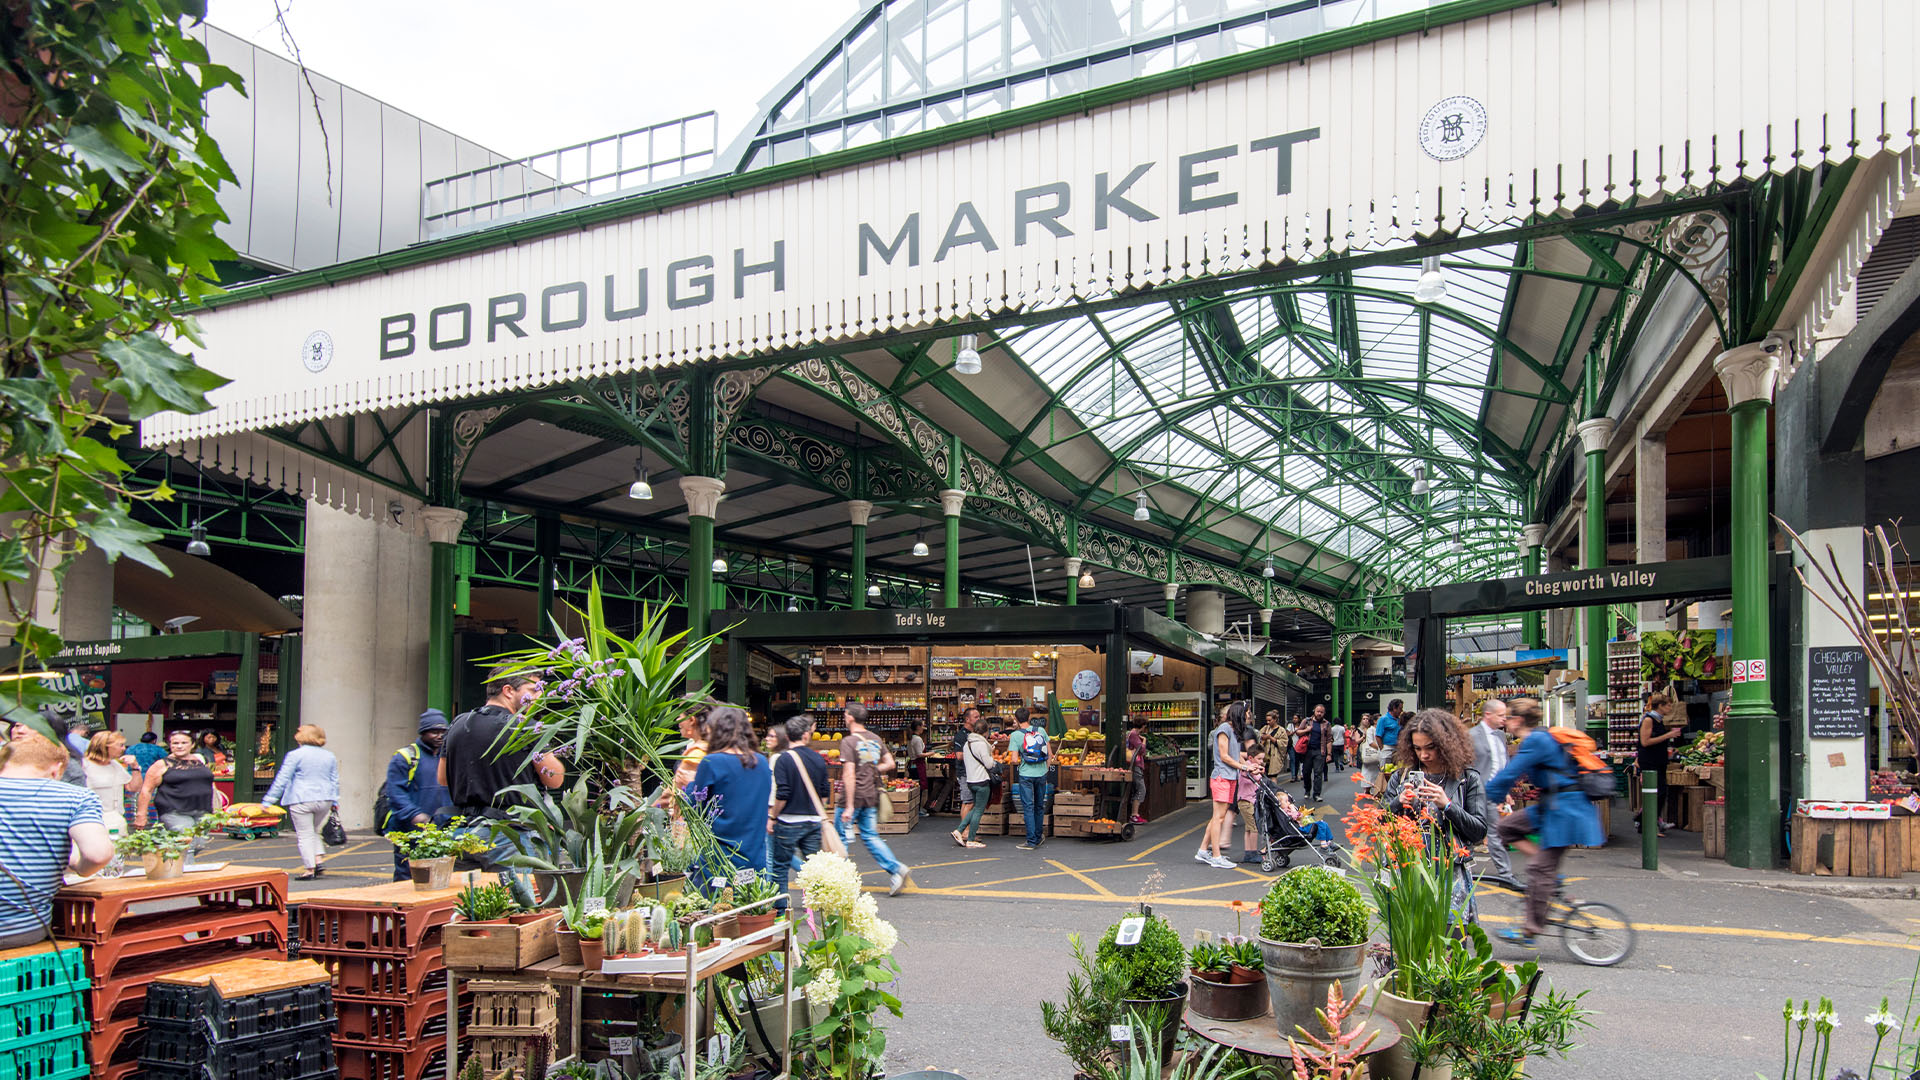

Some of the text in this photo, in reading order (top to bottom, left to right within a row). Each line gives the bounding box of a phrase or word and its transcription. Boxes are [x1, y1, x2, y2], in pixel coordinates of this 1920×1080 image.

[1423, 100, 1484, 143] BOROUGH MARKET
[379, 126, 1320, 360] BOROUGH MARKET
[1525, 570, 1656, 596] Chegworth Valley
[895, 612, 946, 628] Ted's Veg
[75, 645, 93, 656] Fresh
[94, 642, 121, 656] Supplies
[997, 660, 1021, 671] VEG
[1814, 651, 1863, 665] CHEGWORTH
[1825, 664, 1853, 675] VALLEY
